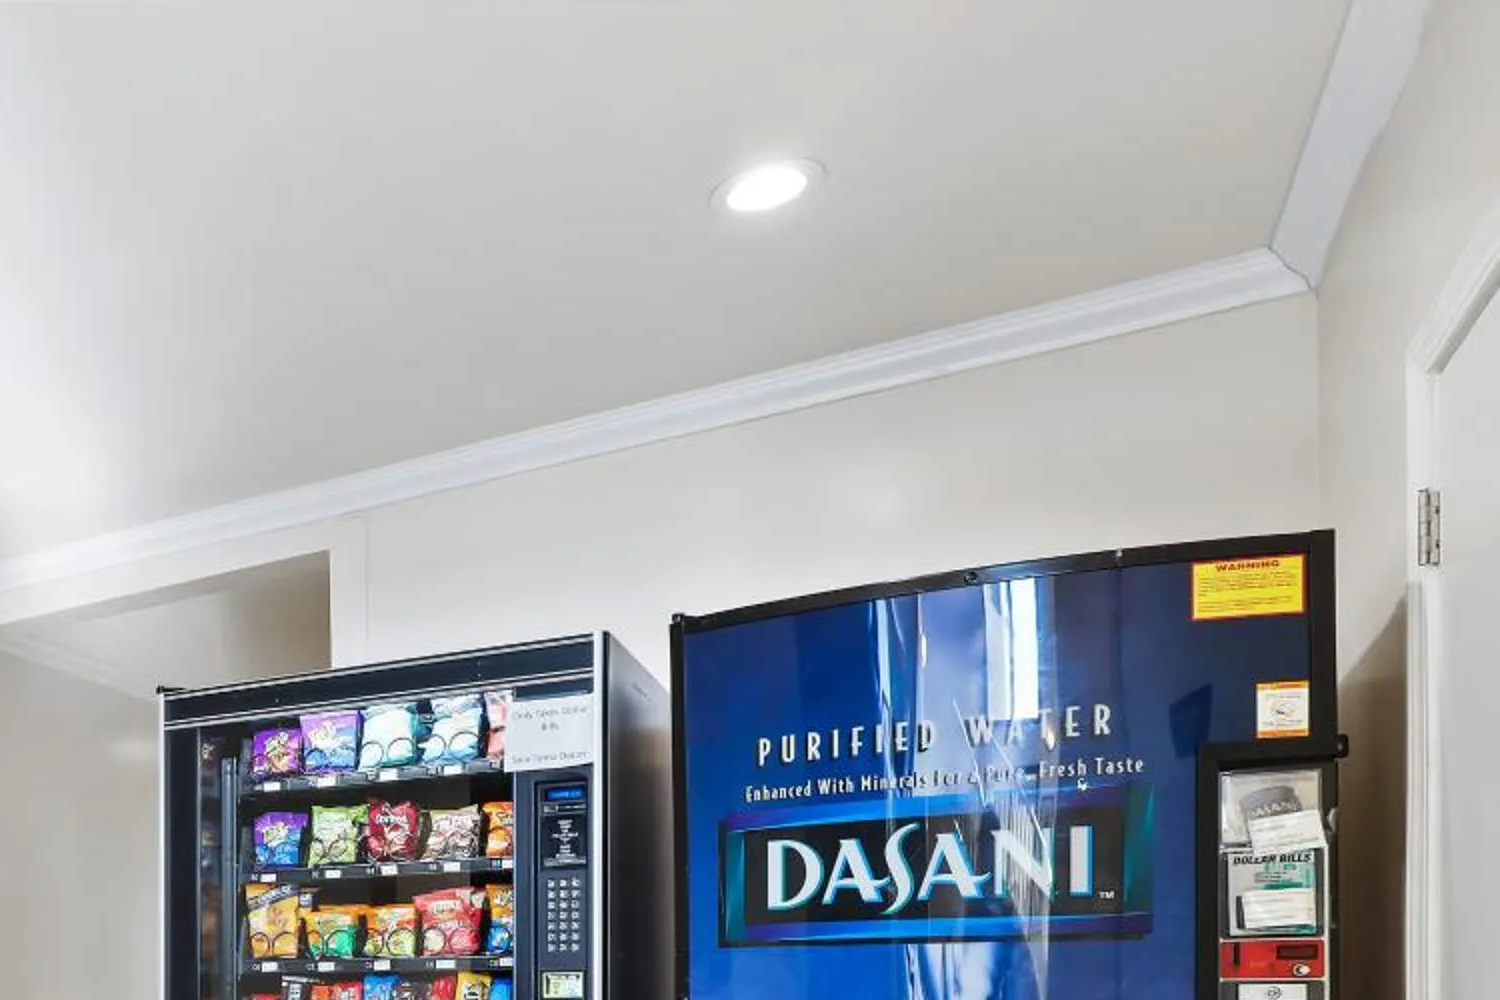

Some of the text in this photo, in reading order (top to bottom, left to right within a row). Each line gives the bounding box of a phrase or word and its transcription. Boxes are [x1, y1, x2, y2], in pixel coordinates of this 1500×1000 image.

[1216, 559, 1280, 572] WARNING
[757, 703, 1112, 767] PURIFIED WATER
[745, 779, 812, 804] Enhanced
[817, 774, 854, 796] With
[861, 771, 927, 791] Minerals
[1040, 758, 1087, 779] Fresh
[1094, 756, 1144, 776] Taste
[767, 822, 1093, 915] DASANI
[1233, 852, 1312, 865] DOLLAR BILLS
